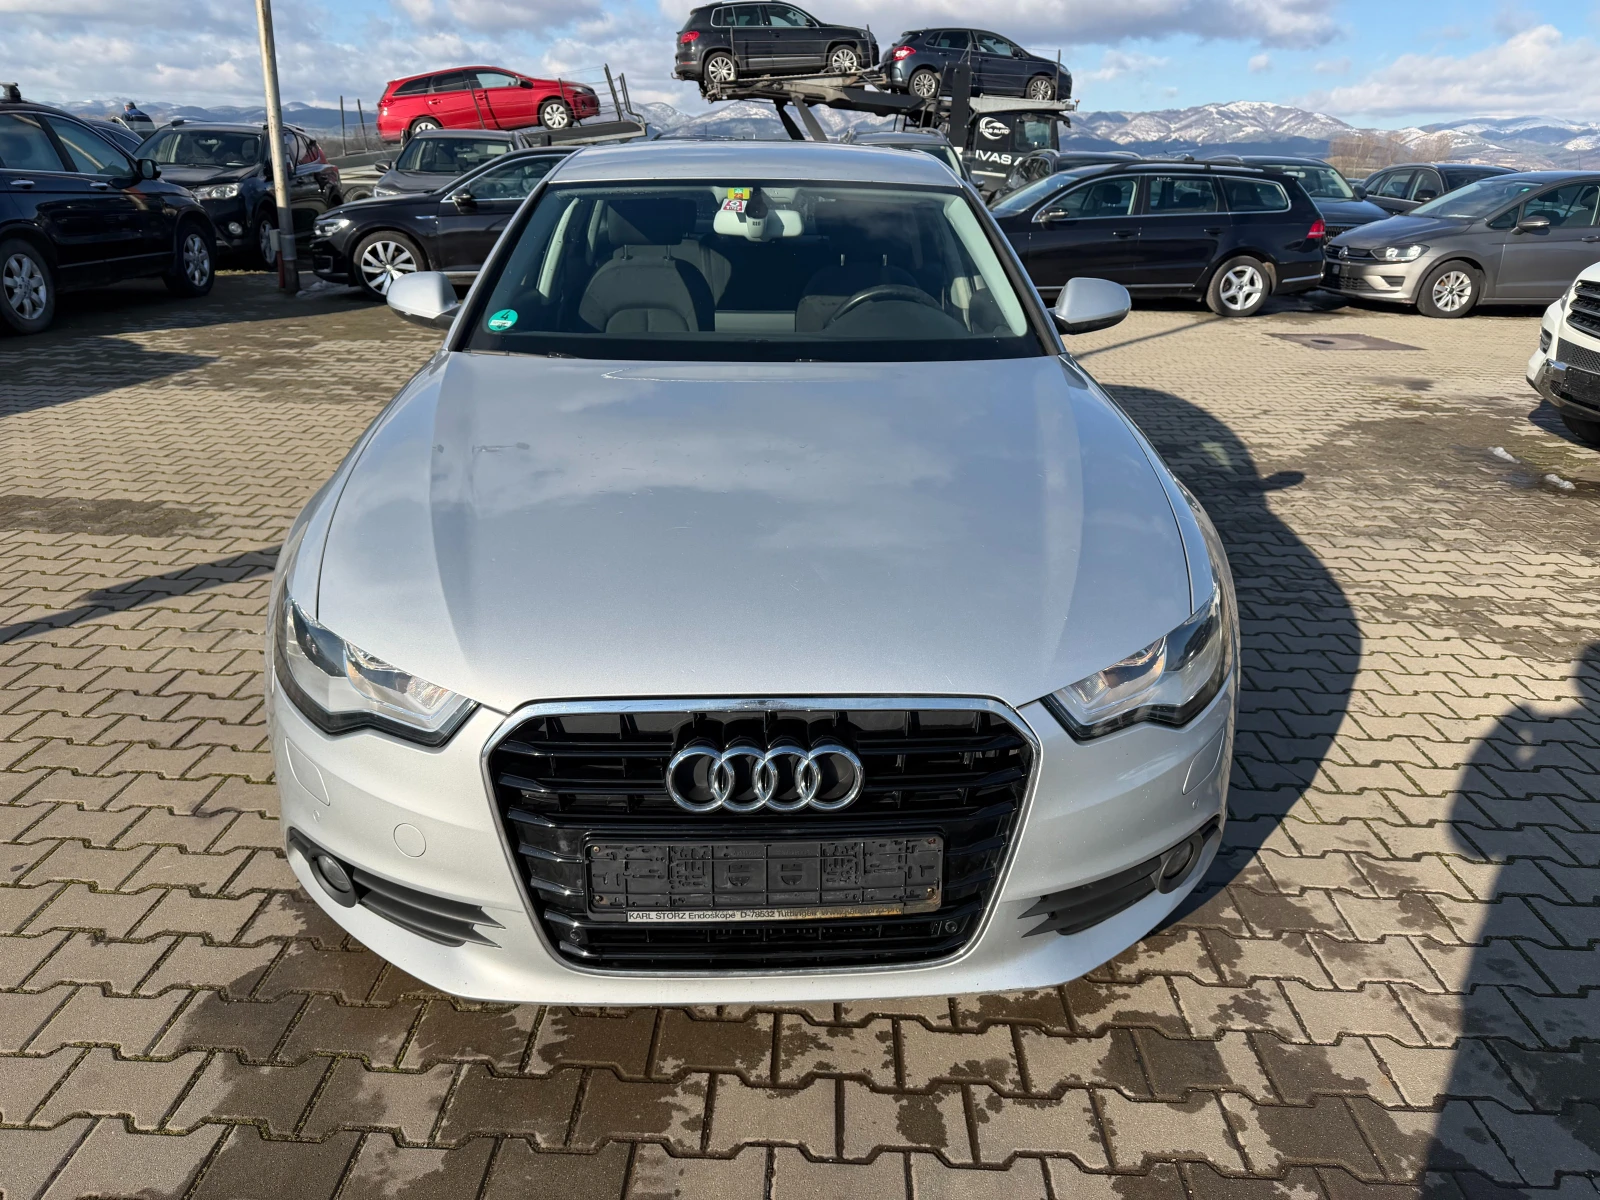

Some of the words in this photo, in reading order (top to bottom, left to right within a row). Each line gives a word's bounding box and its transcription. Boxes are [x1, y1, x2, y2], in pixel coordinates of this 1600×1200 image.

[975, 149, 1012, 165] IVAS
[500, 310, 511, 320] 4
[628, 912, 654, 920] KARL
[656, 912, 687, 920] STORZ
[688, 911, 736, 920] Endoskope
[740, 910, 775, 918] D-78532
